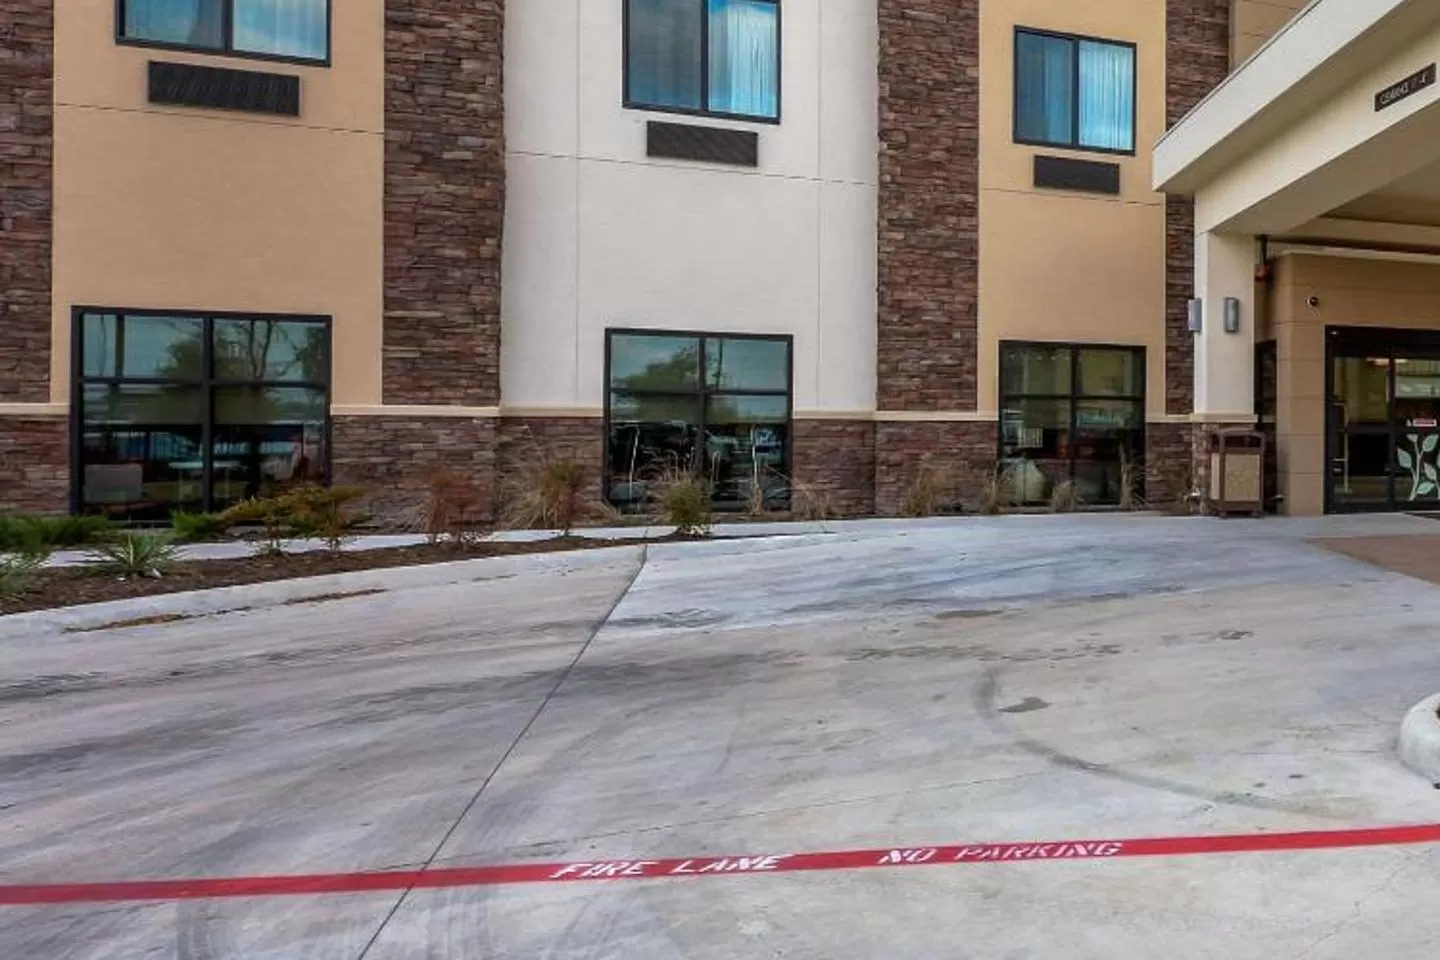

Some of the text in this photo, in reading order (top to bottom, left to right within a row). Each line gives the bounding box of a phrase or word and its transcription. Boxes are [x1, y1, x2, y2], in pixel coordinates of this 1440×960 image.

[549, 841, 1124, 878] FIRE LANE NO PARKING
